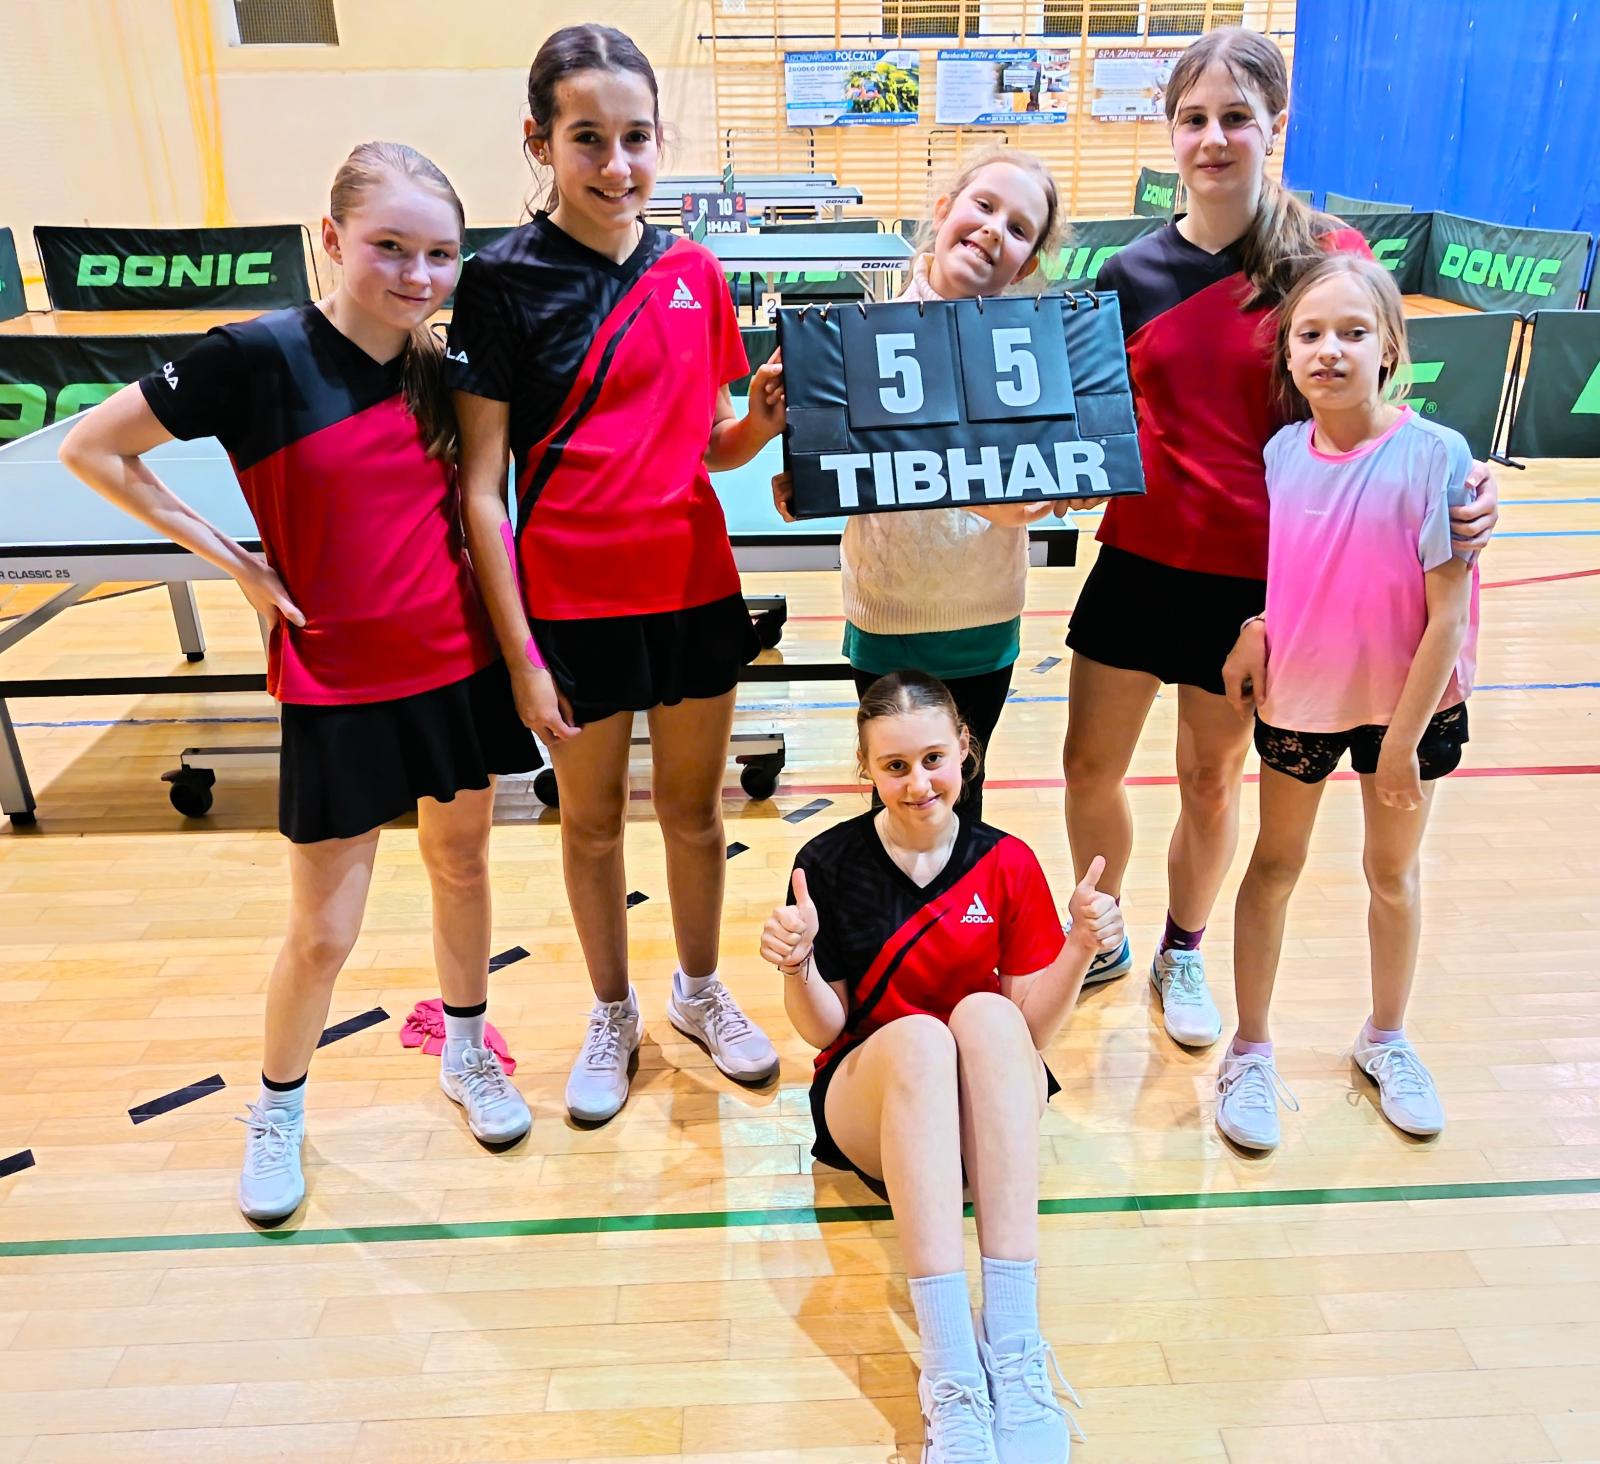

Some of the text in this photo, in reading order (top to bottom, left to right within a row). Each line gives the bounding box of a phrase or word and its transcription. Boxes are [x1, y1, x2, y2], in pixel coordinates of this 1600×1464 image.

[1098, 50, 1115, 58] SPA
[1117, 49, 1155, 60] Zdrojowe
[684, 194, 744, 216] 2 9 10 2
[1142, 183, 1174, 209] DONIC
[687, 220, 741, 233] THAR
[76, 251, 272, 288] DONIC
[1439, 243, 1562, 297] DONIC
[668, 300, 702, 309] JOOLA
[766, 298, 777, 314] 2
[875, 327, 1041, 414] 5 5
[819, 440, 1112, 508] TIBHAR
[8, 569, 53, 579] CLASSIC
[55, 569, 70, 578] 25
[960, 915, 995, 923] JOOLA
